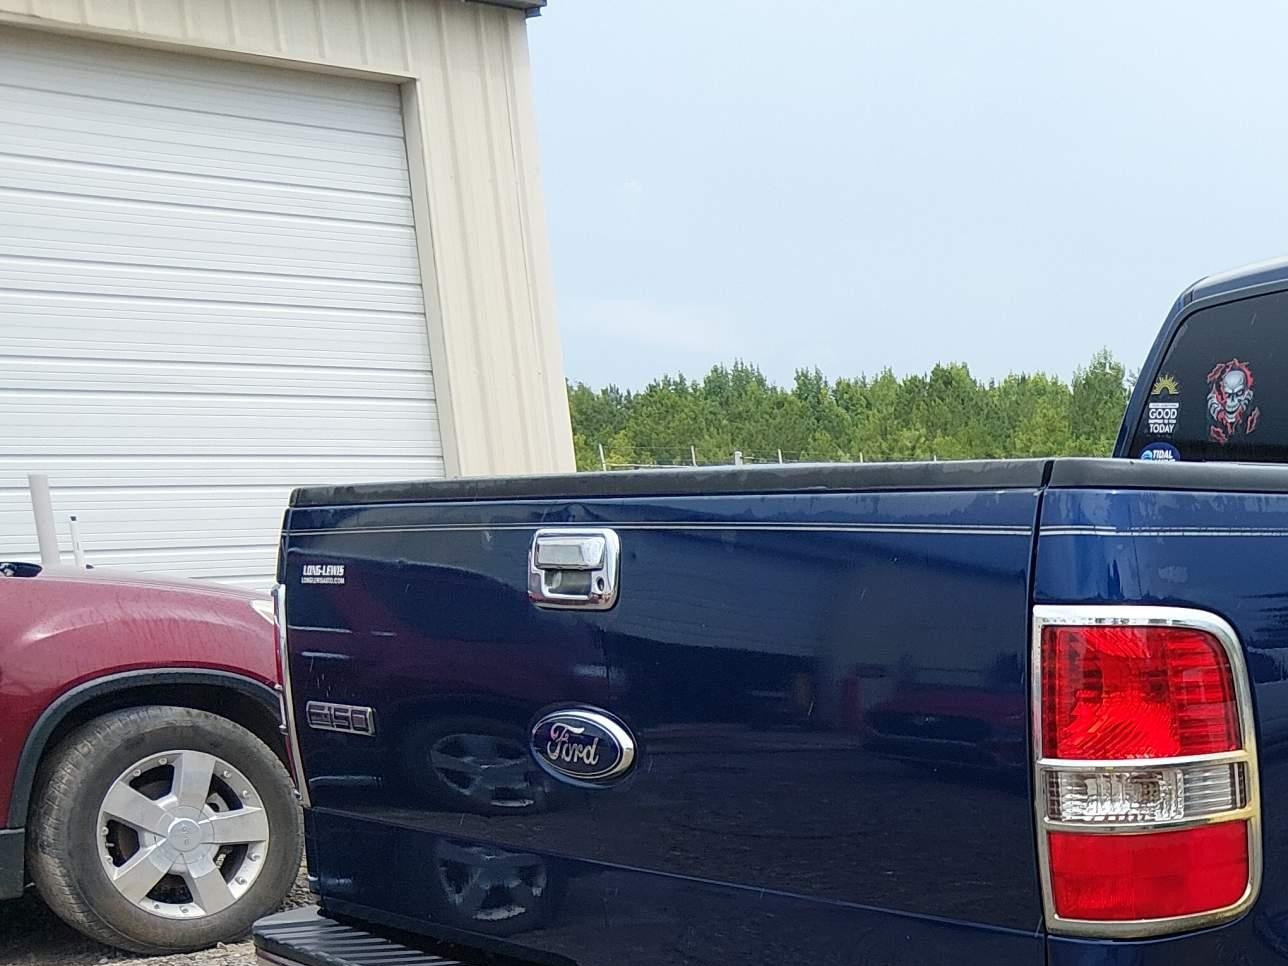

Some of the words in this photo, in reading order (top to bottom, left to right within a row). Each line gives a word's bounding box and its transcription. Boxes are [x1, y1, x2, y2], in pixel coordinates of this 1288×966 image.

[1149, 408, 1177, 419] GOOD
[1149, 423, 1175, 433] TODAY
[1152, 449, 1174, 459] TIDAL
[303, 564, 345, 576] LONG-LEWIS
[546, 722, 600, 766] Ford
